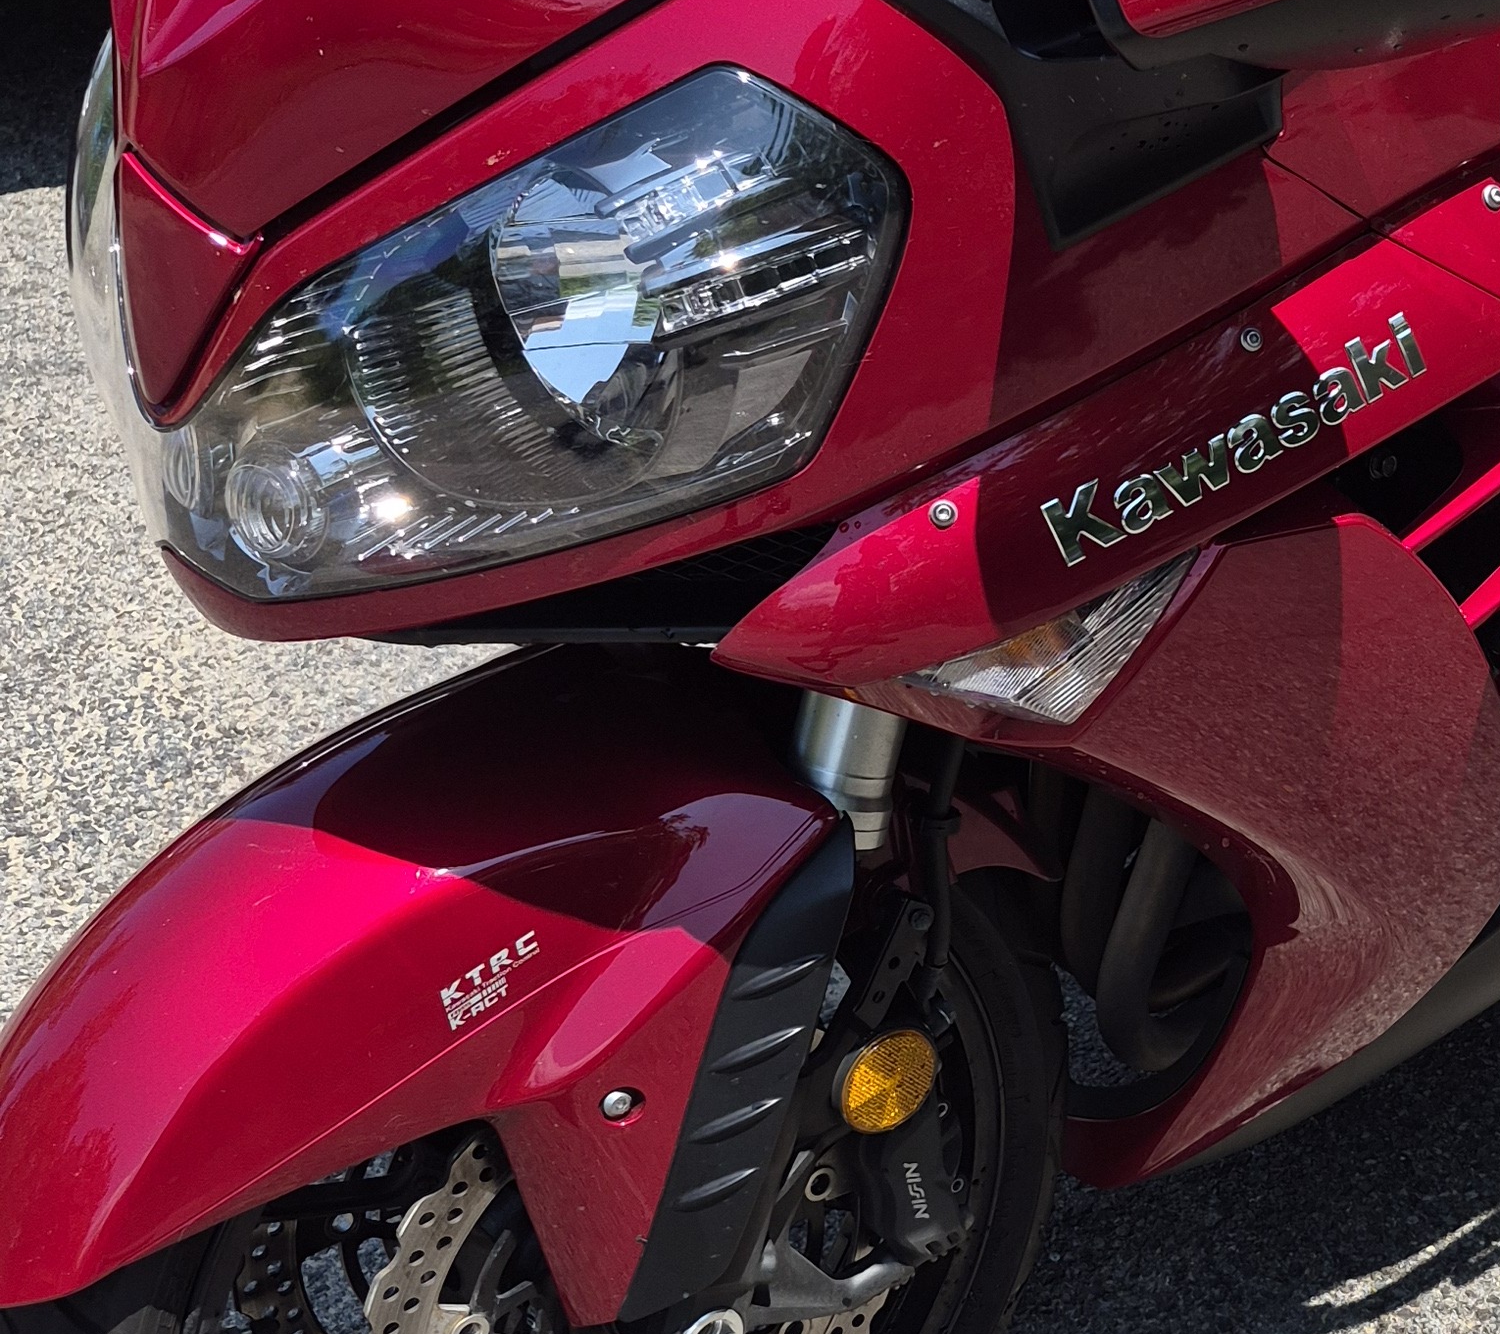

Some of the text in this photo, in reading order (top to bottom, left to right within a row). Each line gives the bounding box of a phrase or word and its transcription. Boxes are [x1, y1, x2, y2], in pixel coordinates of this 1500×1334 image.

[1040, 311, 1427, 567] Kawasaki
[440, 930, 539, 1007] KTRC
[449, 984, 508, 1031] K-ACT
